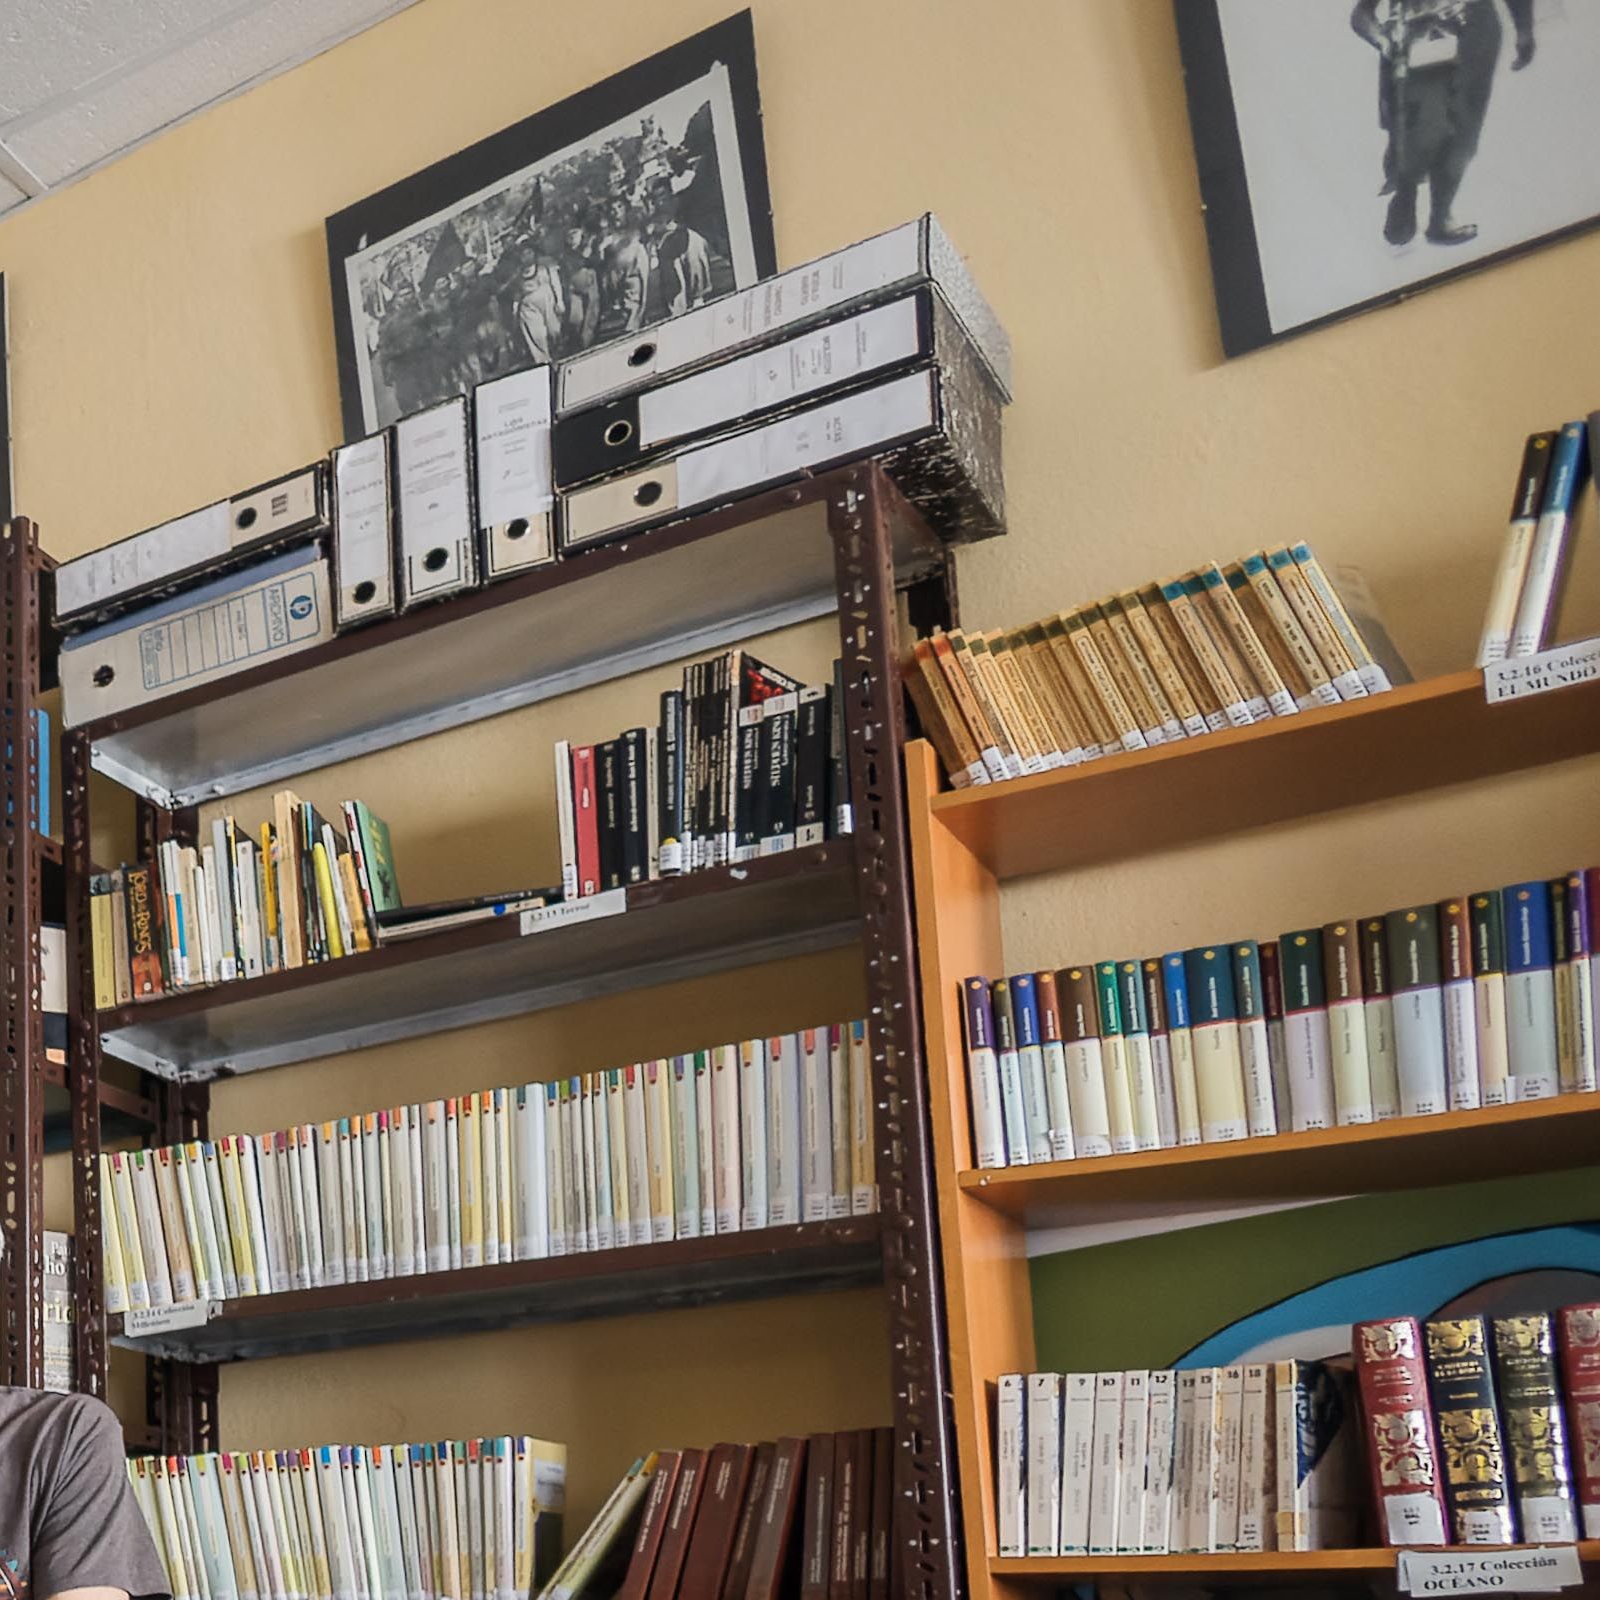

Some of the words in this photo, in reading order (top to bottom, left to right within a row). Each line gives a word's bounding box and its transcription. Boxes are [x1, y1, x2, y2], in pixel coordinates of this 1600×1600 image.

[267, 588, 285, 642] ARCHIVO
[1527, 665, 1597, 690] MUNDO
[1431, 1562, 1476, 1578] 3.2.17
[1480, 1556, 1558, 1574] Colección
[1423, 1571, 1504, 1592] OCÉANO
